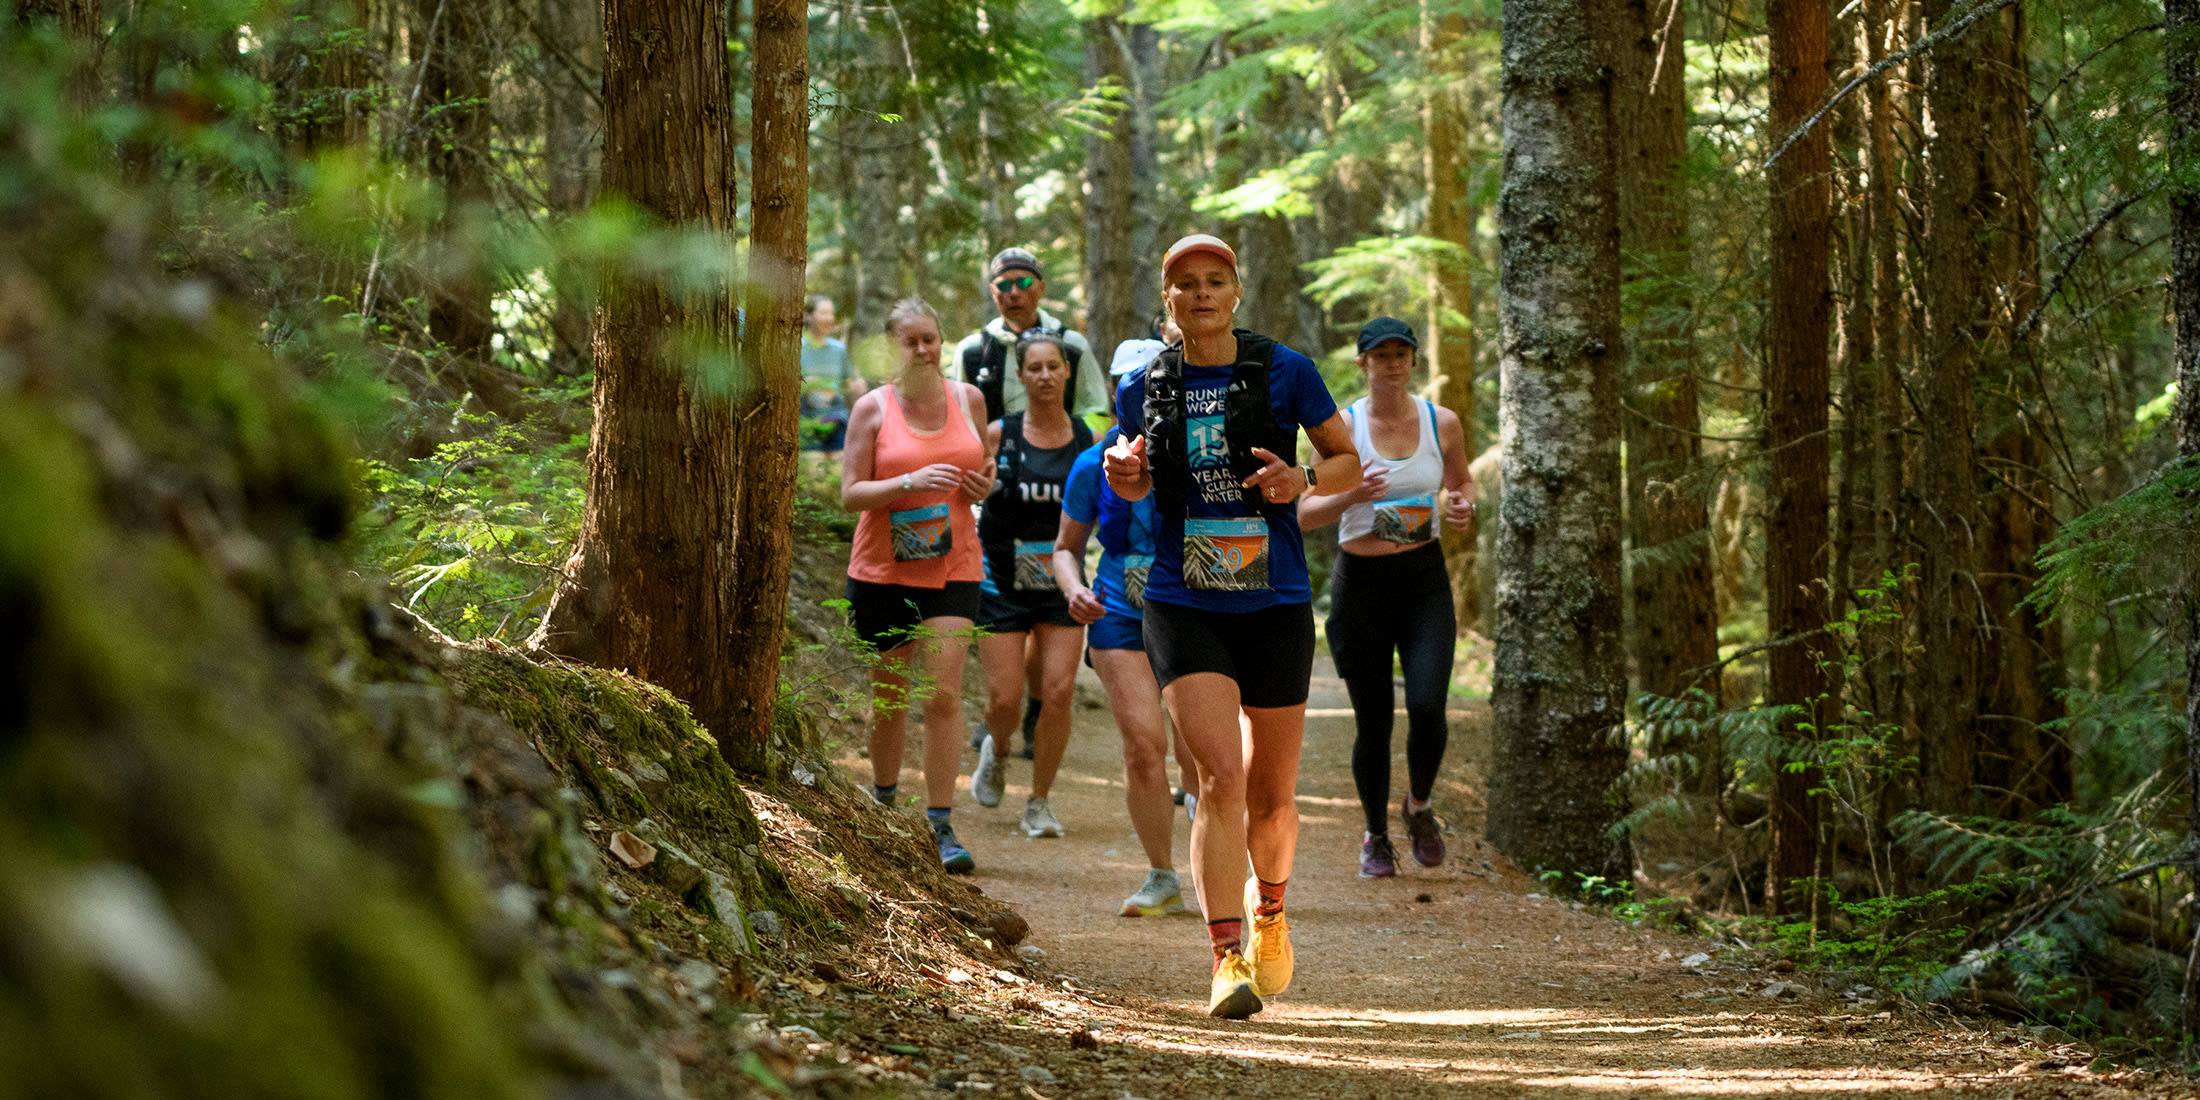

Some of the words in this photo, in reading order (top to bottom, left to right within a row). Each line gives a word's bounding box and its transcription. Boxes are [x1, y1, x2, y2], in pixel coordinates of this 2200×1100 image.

[1186, 388, 1217, 402] RUN
[1192, 424, 1229, 457] 15
[1192, 468, 1236, 484] YEAR
[1201, 489, 1243, 504] WATER
[1210, 547, 1243, 573] 29
